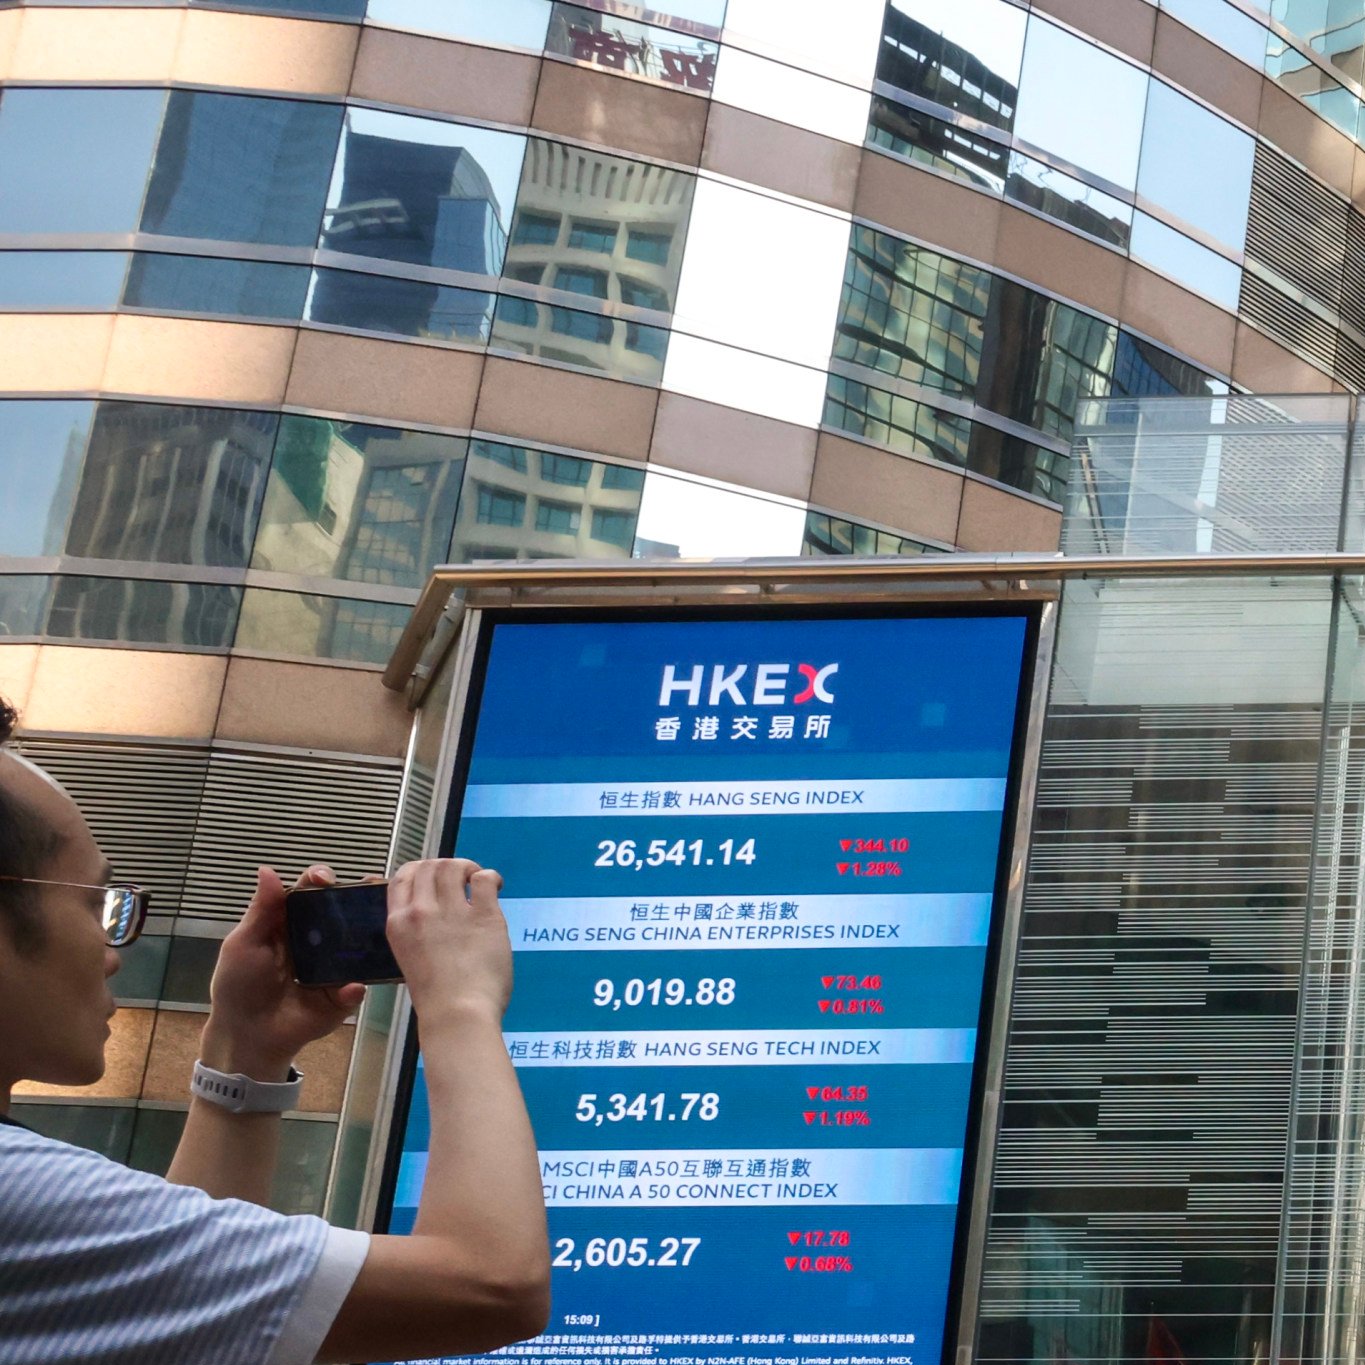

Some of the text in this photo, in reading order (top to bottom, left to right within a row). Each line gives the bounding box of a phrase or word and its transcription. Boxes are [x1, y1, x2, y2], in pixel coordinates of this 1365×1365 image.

[659, 663, 838, 706] HKEX
[655, 715, 831, 740] 香港交易所
[599, 791, 864, 809] 恒生指數 HANG SENG INDEX
[595, 839, 755, 870] 26,541.14
[630, 902, 799, 921] 恒生中國企業指數
[523, 925, 900, 942] HANG SENG CHINA ENTERPRISES INDEX
[594, 978, 735, 1010] 9,019.88
[509, 1040, 881, 1060] 恒生科技指數 HANG SENG TECH INDEX
[576, 1093, 719, 1126] 5,341.78
[542, 1184, 838, 1199] CI CHINA A 50 CONNECT INDEX
[551, 1238, 701, 1271] 2,605.27
[565, 1315, 593, 1324] 15:09
